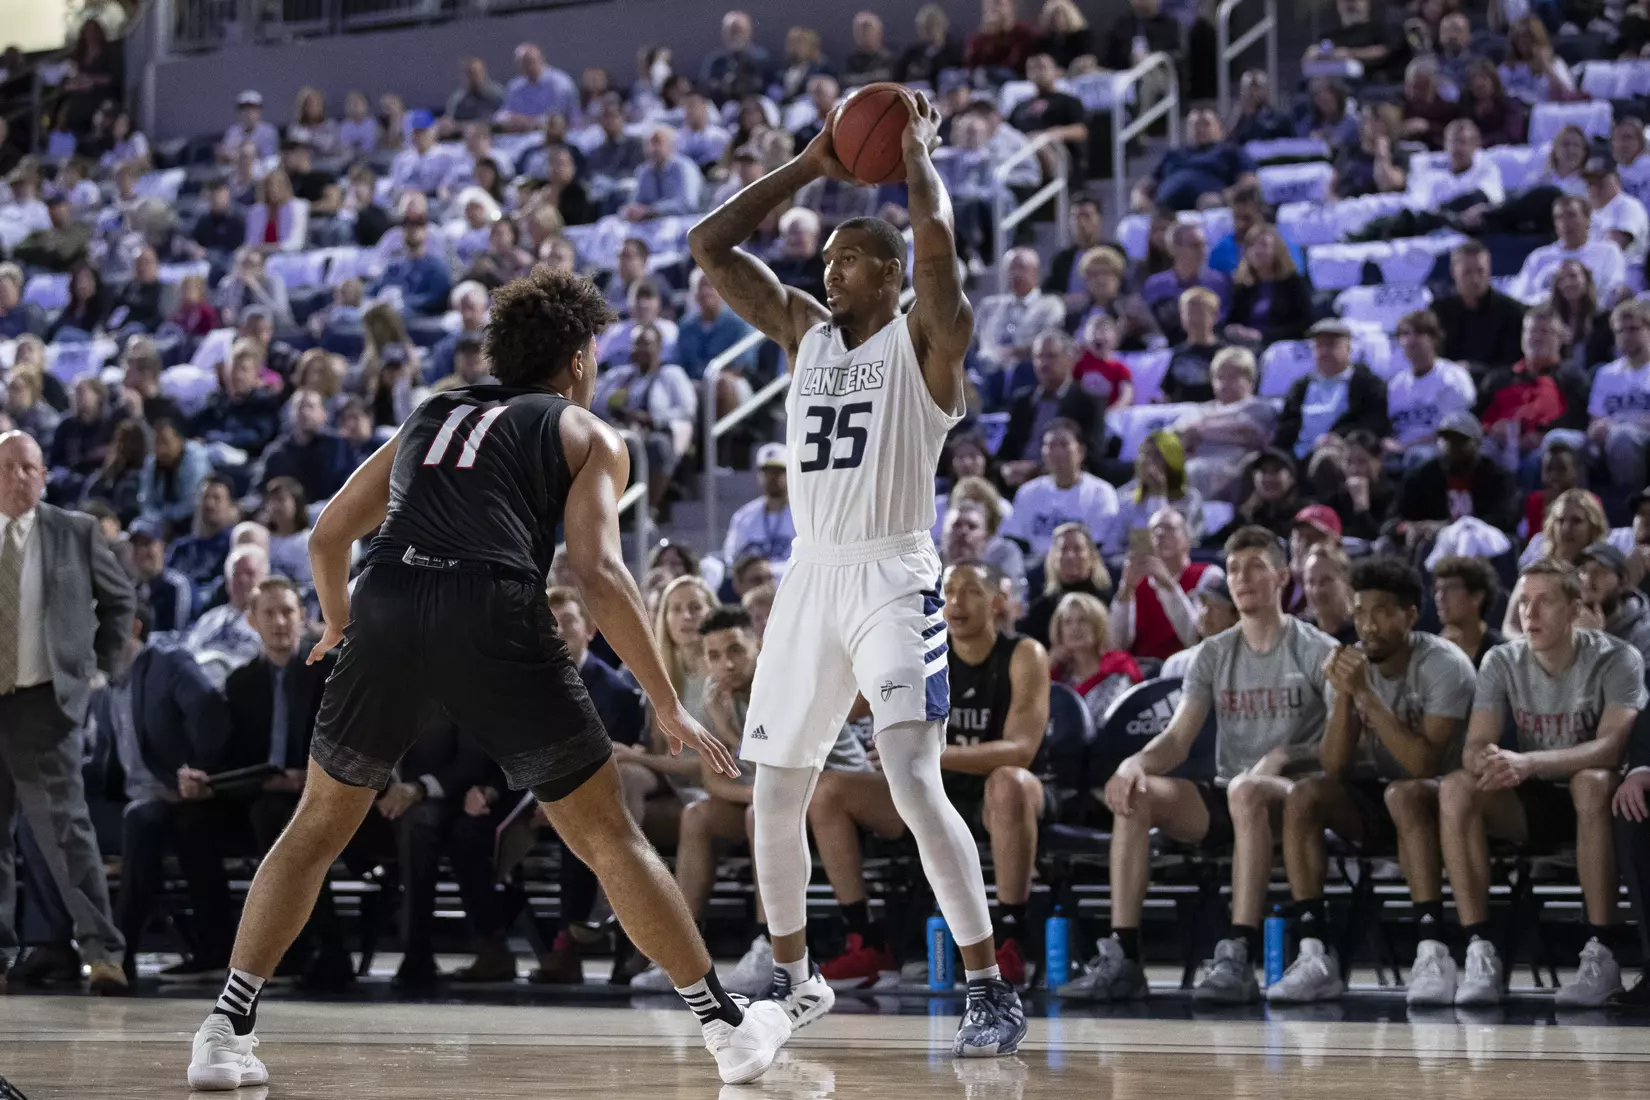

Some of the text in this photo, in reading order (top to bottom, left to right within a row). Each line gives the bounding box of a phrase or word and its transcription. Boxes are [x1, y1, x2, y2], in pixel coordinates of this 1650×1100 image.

[800, 361, 884, 396] LANCERS
[421, 404, 509, 469] 11
[800, 401, 873, 473] 35
